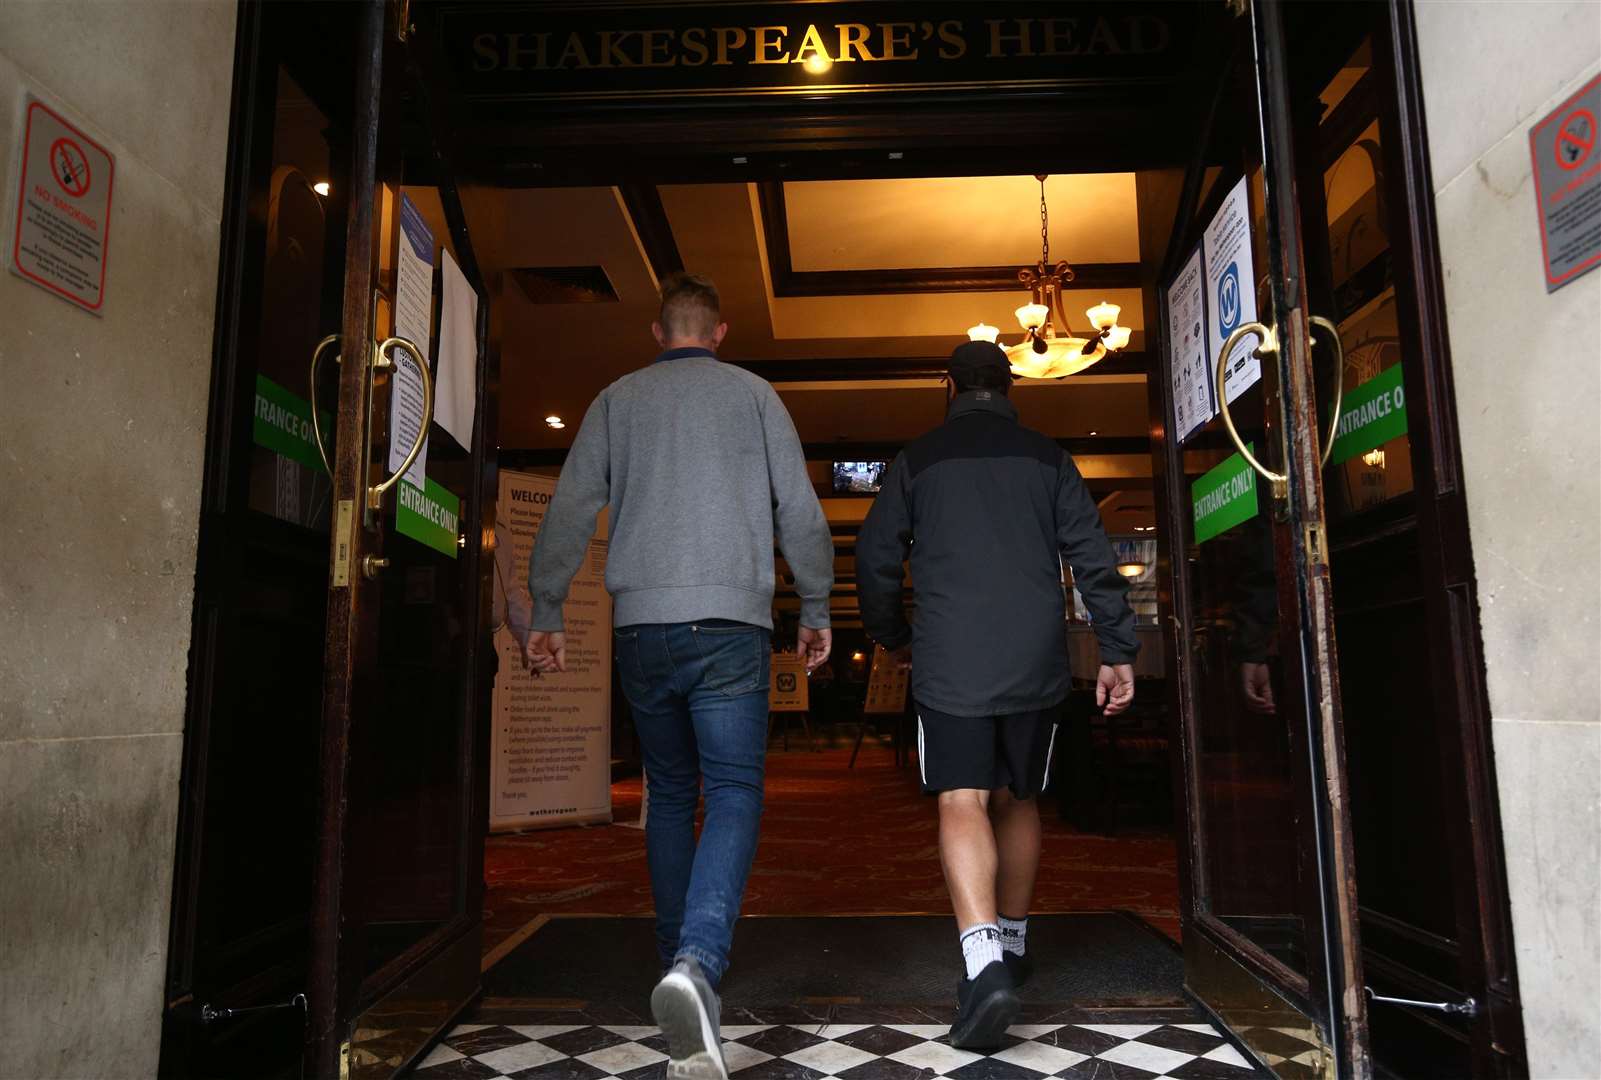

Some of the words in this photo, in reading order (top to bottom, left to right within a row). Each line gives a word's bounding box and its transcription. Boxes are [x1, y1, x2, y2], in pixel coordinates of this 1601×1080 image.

[472, 20, 967, 71] SHAKESPEARE'S
[984, 15, 1170, 58] HEAD
[34, 185, 50, 203] NO
[53, 196, 97, 232] SMOKING
[1335, 392, 1392, 440] NTRANCE
[400, 483, 440, 525] ENTRANCE
[440, 507, 458, 535] ONLY
[1194, 481, 1231, 522] ENTRANCE
[1231, 466, 1253, 499] ONLY
[502, 791, 516, 799] Thank
[529, 807, 577, 816] wetherspoon
